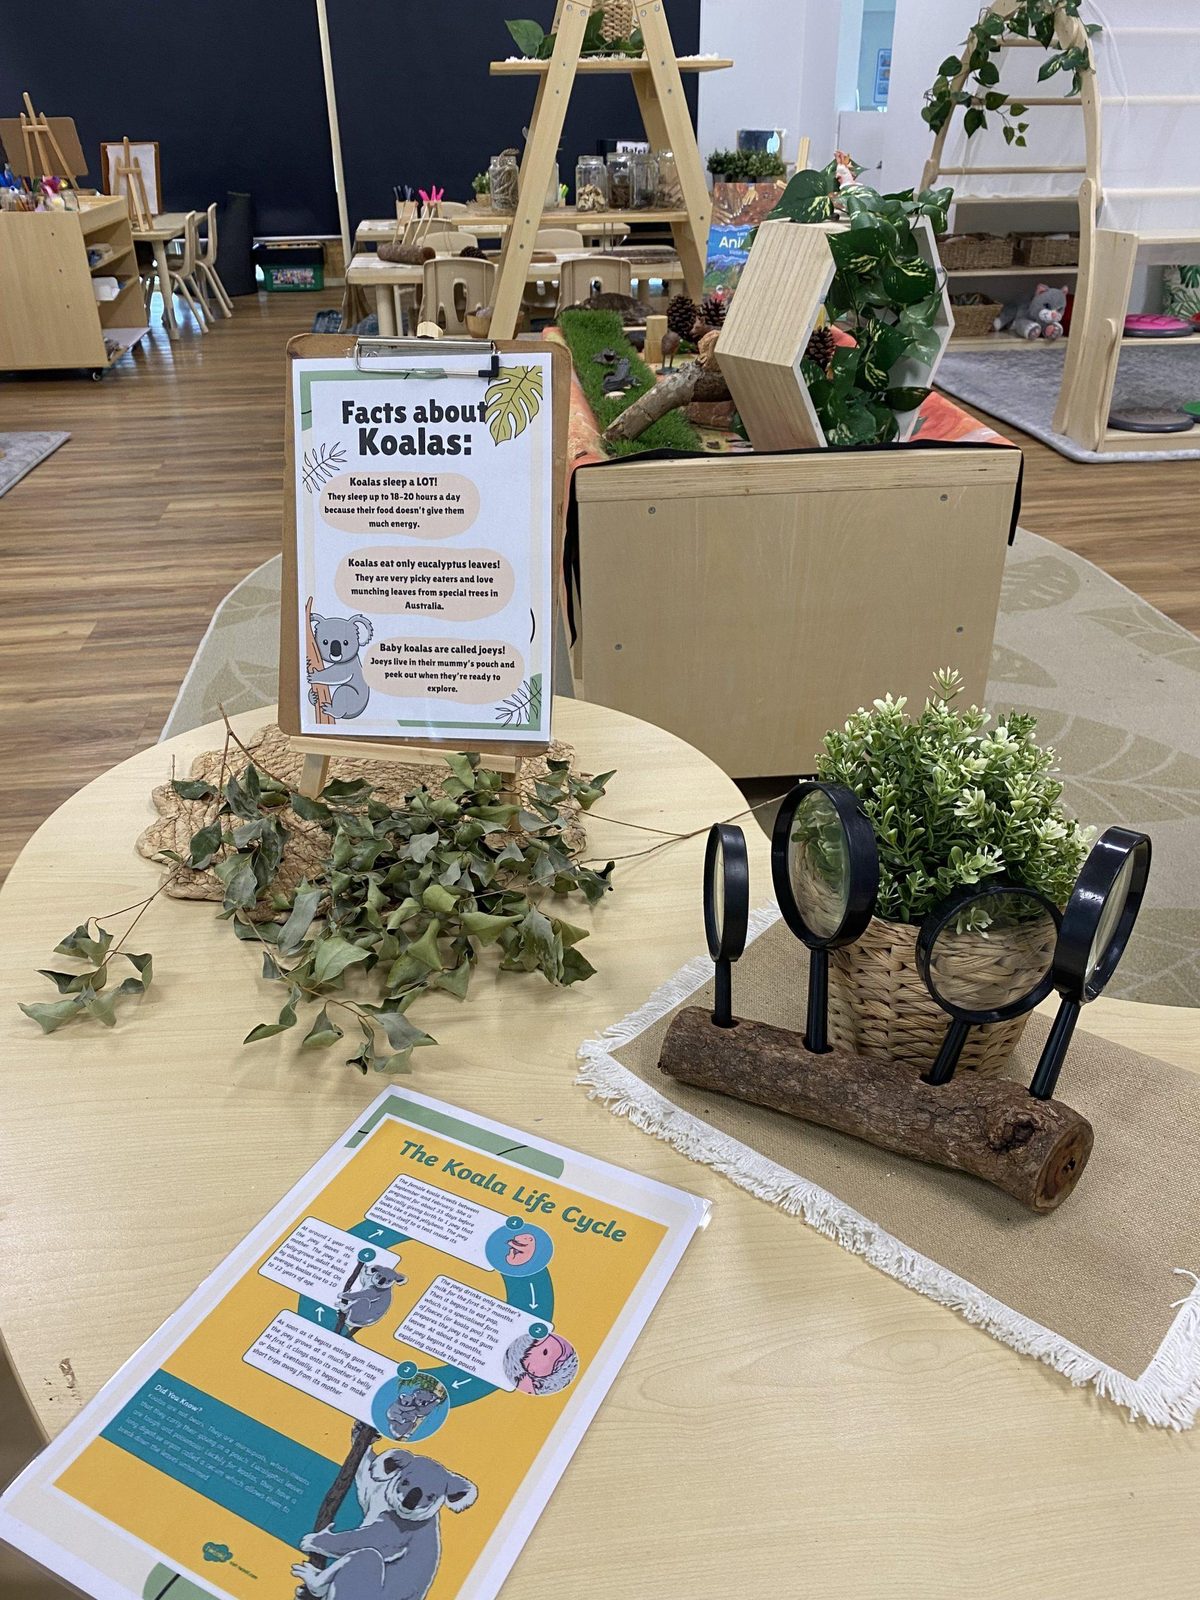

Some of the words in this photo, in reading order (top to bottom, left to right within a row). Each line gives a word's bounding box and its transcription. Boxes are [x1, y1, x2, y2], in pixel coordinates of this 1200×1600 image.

[342, 401, 406, 424] Facts
[413, 399, 486, 424] about
[359, 427, 471, 456] Koalas:
[350, 478, 380, 486] Koalas
[383, 477, 407, 488] sleep
[417, 477, 437, 486] LOT!
[325, 506, 355, 514] because
[357, 506, 375, 514] their
[377, 506, 394, 514] food
[396, 506, 425, 514] doesn't
[427, 506, 443, 516] give
[328, 493, 346, 502] They
[348, 493, 368, 502] sleep
[446, 493, 460, 502] day
[348, 559, 378, 567] Koalas
[396, 559, 415, 570] only
[418, 560, 466, 570] eucalyptus
[469, 560, 500, 568] leaves!
[351, 588, 389, 597] munching
[418, 588, 437, 596] from
[439, 589, 466, 598] special
[490, 589, 498, 597] in
[355, 574, 374, 583] They
[410, 574, 431, 584] picky
[405, 602, 444, 610] Australia.
[370, 658, 392, 666] Joeys
[438, 660, 474, 668] mummy's
[476, 661, 498, 669] pouch
[380, 644, 402, 653] Baby
[404, 644, 432, 652] koalas
[451, 645, 477, 653] called
[479, 646, 505, 656] joeys!
[385, 671, 402, 679] peek
[440, 672, 467, 681] they're
[469, 673, 491, 682] ready
[428, 685, 458, 693] explore.
[400, 1140, 438, 1167] The
[442, 1158, 508, 1196] Koala
[512, 1186, 556, 1214] Life
[562, 1206, 627, 1242] Cycle
[429, 1290, 443, 1300] Then
[449, 1299, 468, 1311] begins
[485, 1316, 498, 1326] pap,
[440, 1278, 451, 1286] The
[449, 1283, 464, 1292] joey
[463, 1289, 482, 1300] drinks
[482, 1297, 496, 1307] only
[495, 1303, 521, 1317] mother's
[424, 1298, 442, 1308] which
[453, 1311, 485, 1328] specialised
[483, 1324, 499, 1334] form
[402, 1324, 414, 1332] the
[411, 1329, 426, 1339] joey
[426, 1334, 446, 1347] begins
[452, 1348, 472, 1360] spend
[470, 1356, 486, 1366] time
[412, 1311, 438, 1325] prepares
[437, 1321, 448, 1330] the
[446, 1327, 461, 1336] joey
[468, 1336, 480, 1344] eat
[478, 1341, 494, 1351] gum
[270, 1325, 281, 1334] the
[280, 1331, 294, 1341] joey
[293, 1338, 312, 1349] grows
[327, 1354, 344, 1365] much
[343, 1361, 363, 1373] faster
[270, 1336, 285, 1347] first,
[291, 1347, 309, 1358] clings
[308, 1355, 323, 1365] onto
[330, 1366, 356, 1382] mother's
[356, 1378, 372, 1390] belly
[284, 1323, 299, 1332] soon
[313, 1335, 332, 1348] begins
[332, 1346, 351, 1359] eating
[350, 1355, 366, 1365] gum
[365, 1361, 384, 1375] leaves,
[252, 1348, 268, 1358] short
[267, 1355, 281, 1365] trips
[281, 1362, 298, 1375] away
[295, 1370, 312, 1381] from
[282, 1352, 313, 1372] Eventually,
[320, 1371, 340, 1384] begins
[349, 1386, 366, 1397] make
[154, 1384, 169, 1395] Did
[167, 1391, 180, 1402] You
[179, 1398, 203, 1412] Know?
